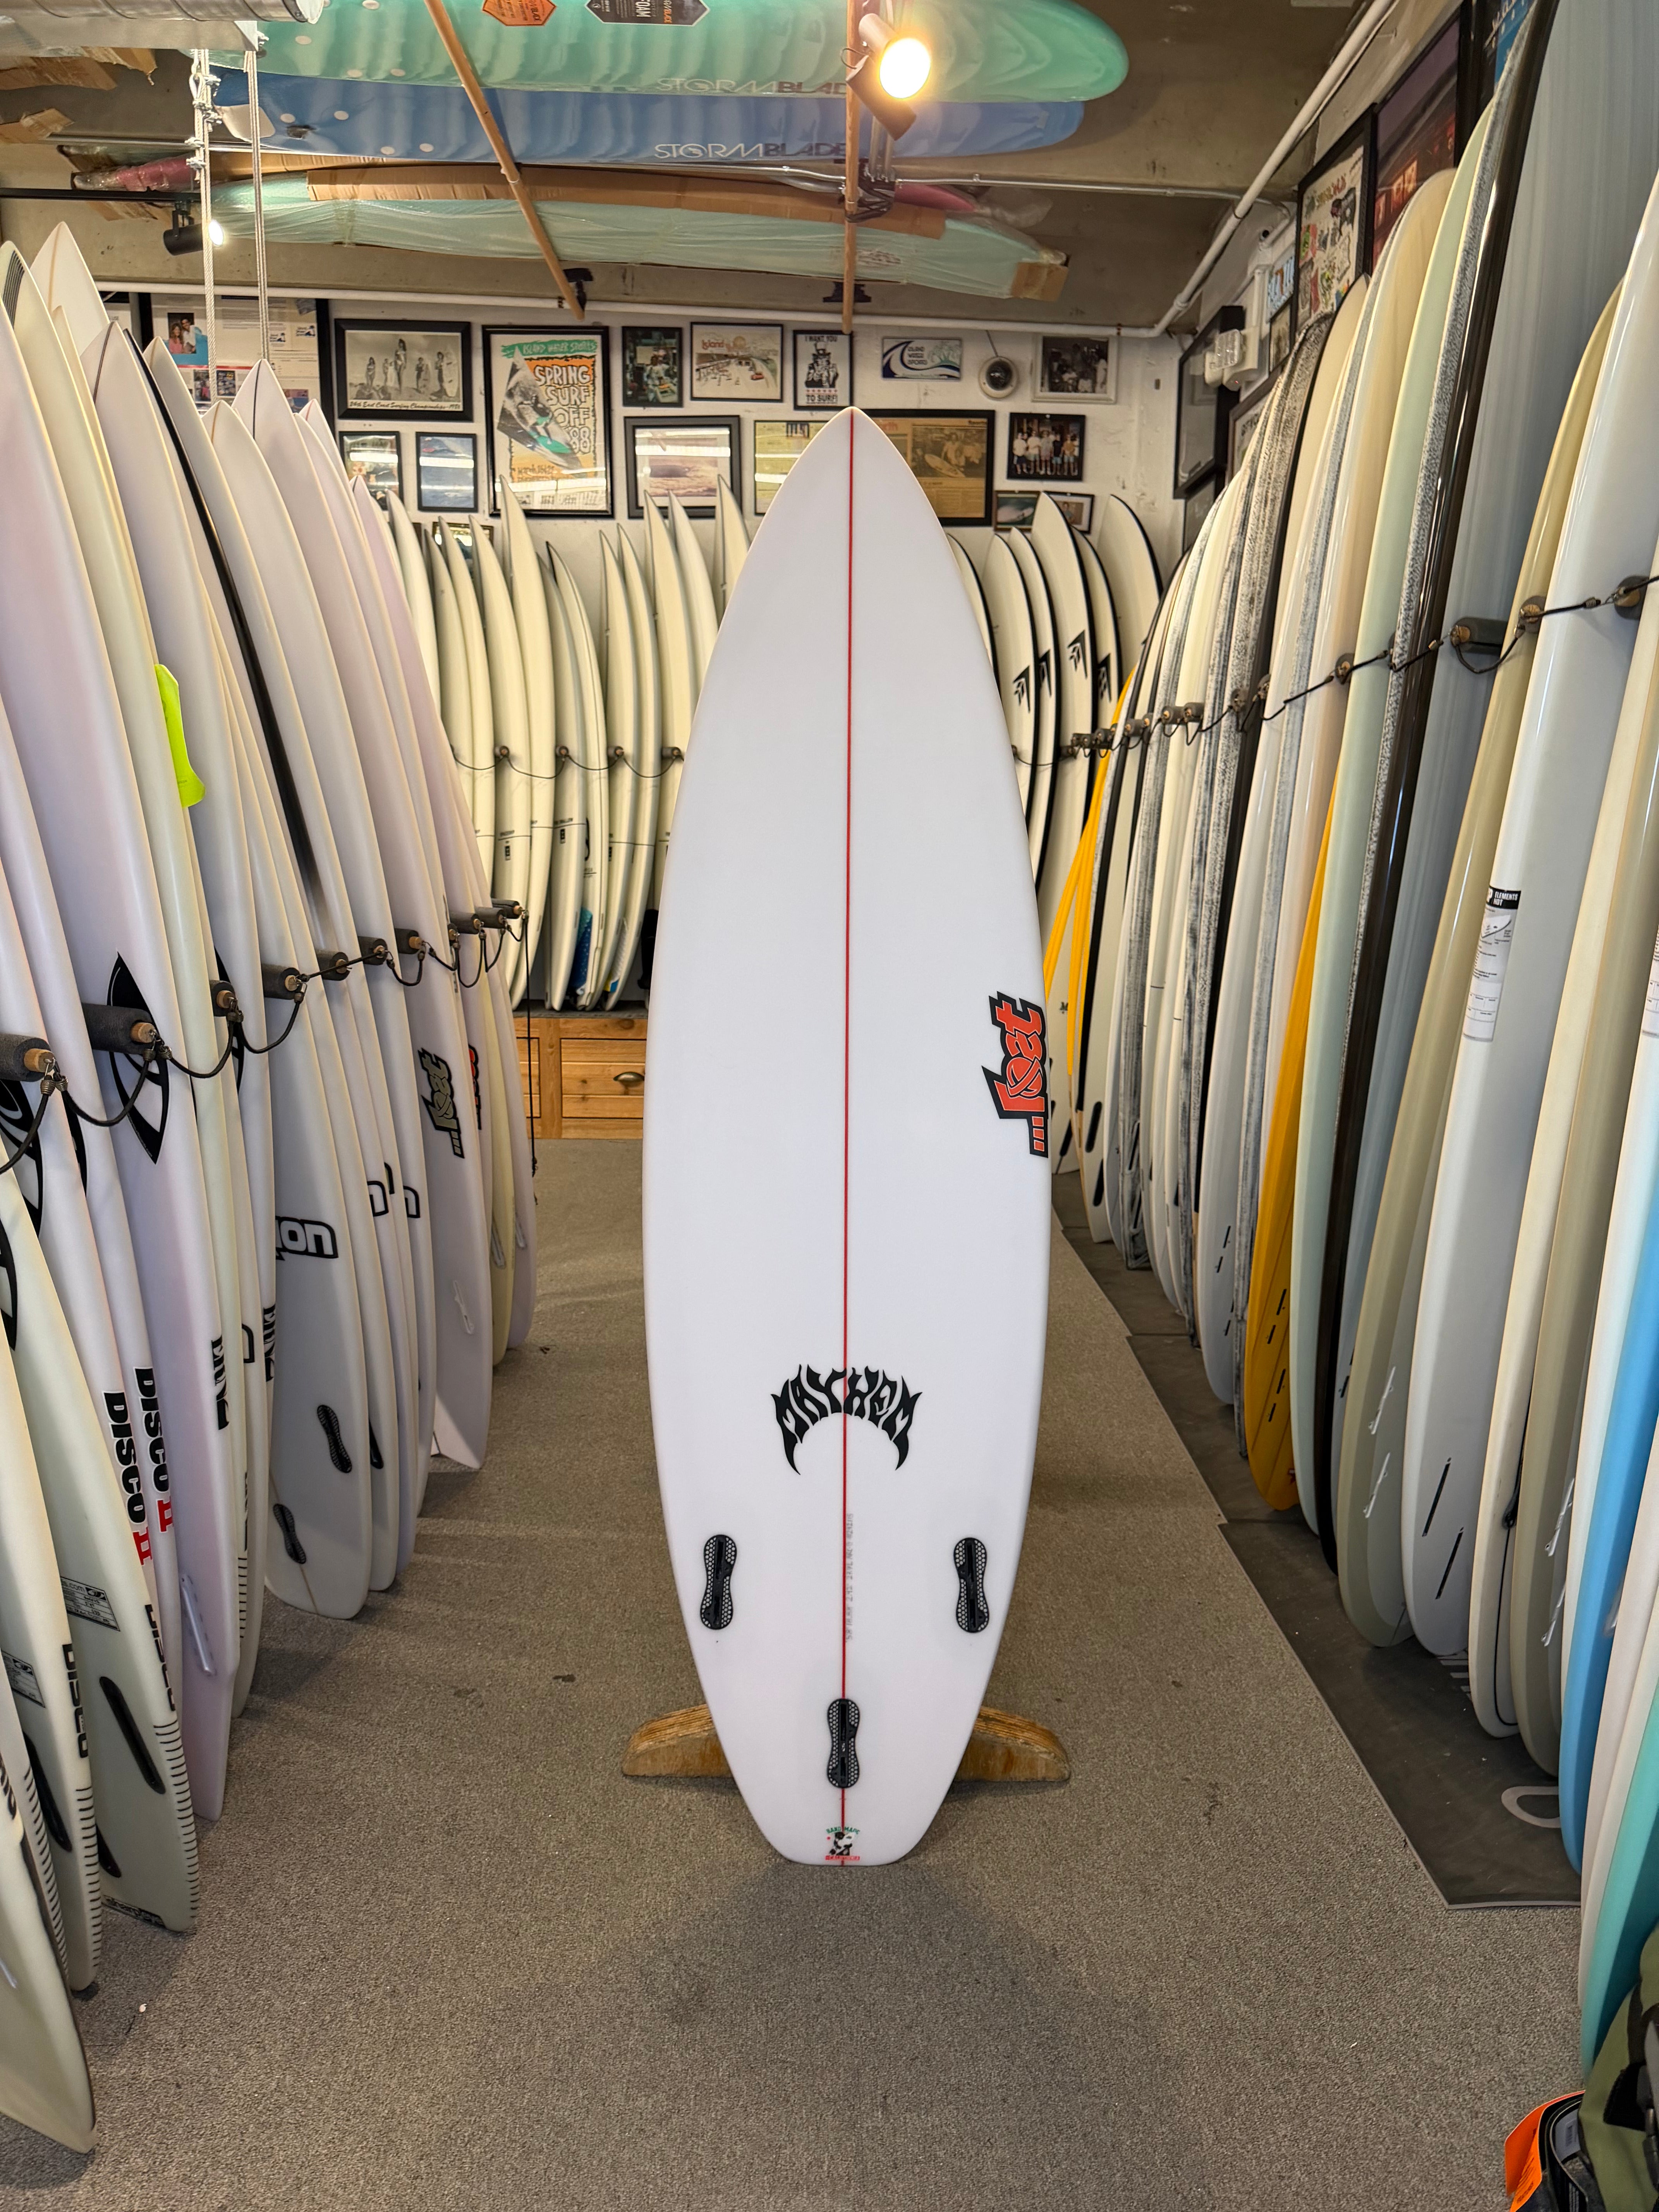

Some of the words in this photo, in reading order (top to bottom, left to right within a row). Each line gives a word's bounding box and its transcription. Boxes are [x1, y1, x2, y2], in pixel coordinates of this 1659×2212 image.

[657, 79, 846, 94] STORMBLAD
[534, 364, 591, 386] SPRING
[546, 385, 590, 406] SURF
[553, 407, 590, 428] OFF
[1494, 891, 1518, 901] ELEMENTS
[133, 1367, 170, 1492] DISCO
[771, 1364, 922, 1475] MAYHEM
[103, 1391, 148, 1524] DISCO
